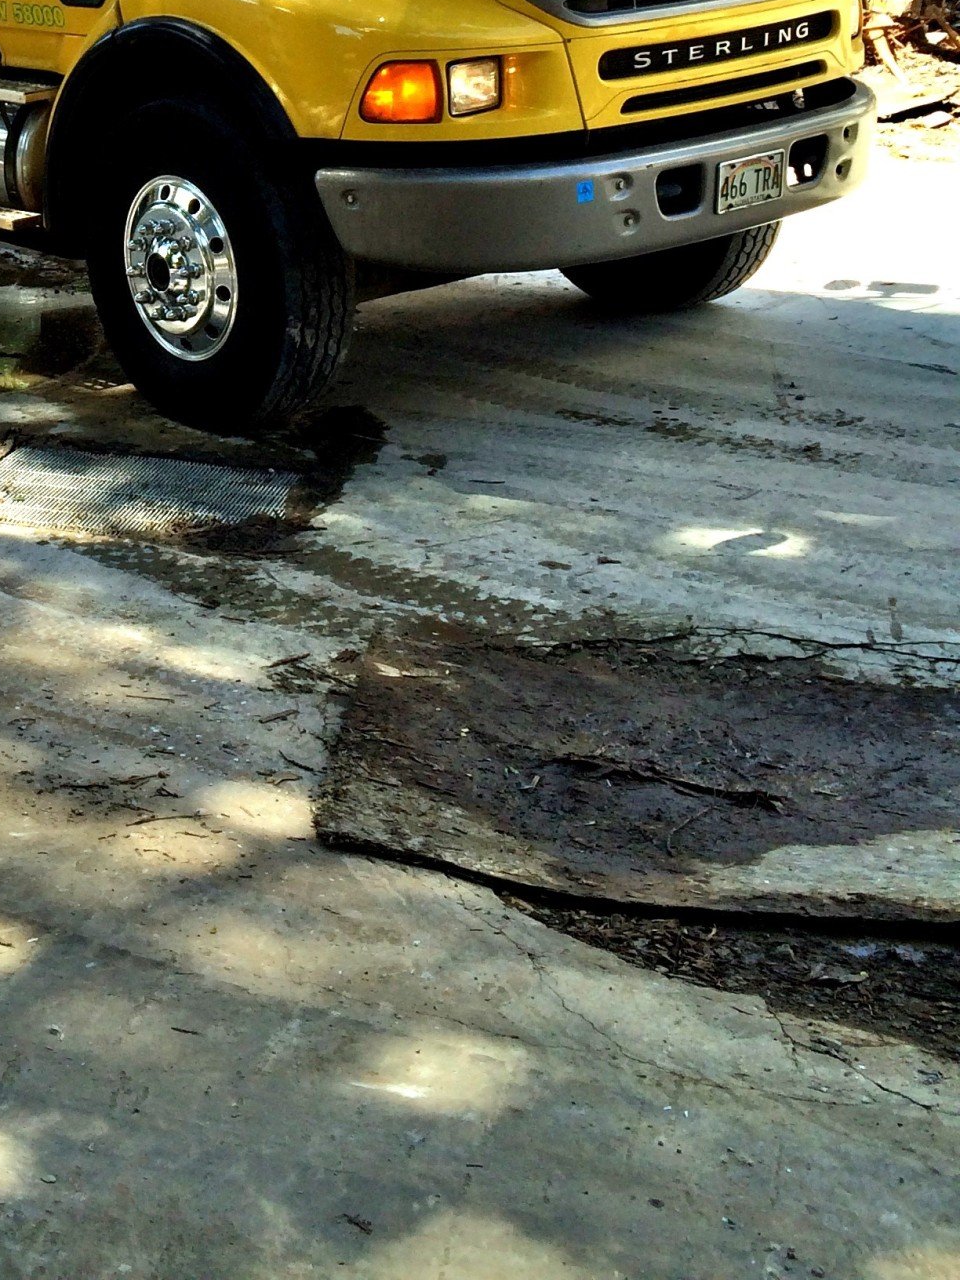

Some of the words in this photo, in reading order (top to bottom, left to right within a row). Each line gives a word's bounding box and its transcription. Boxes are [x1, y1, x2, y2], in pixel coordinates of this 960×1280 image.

[12, 2, 65, 28] 58000
[633, 21, 809, 69] STERLING
[720, 172, 748, 201] 466
[754, 164, 780, 194] TRA
